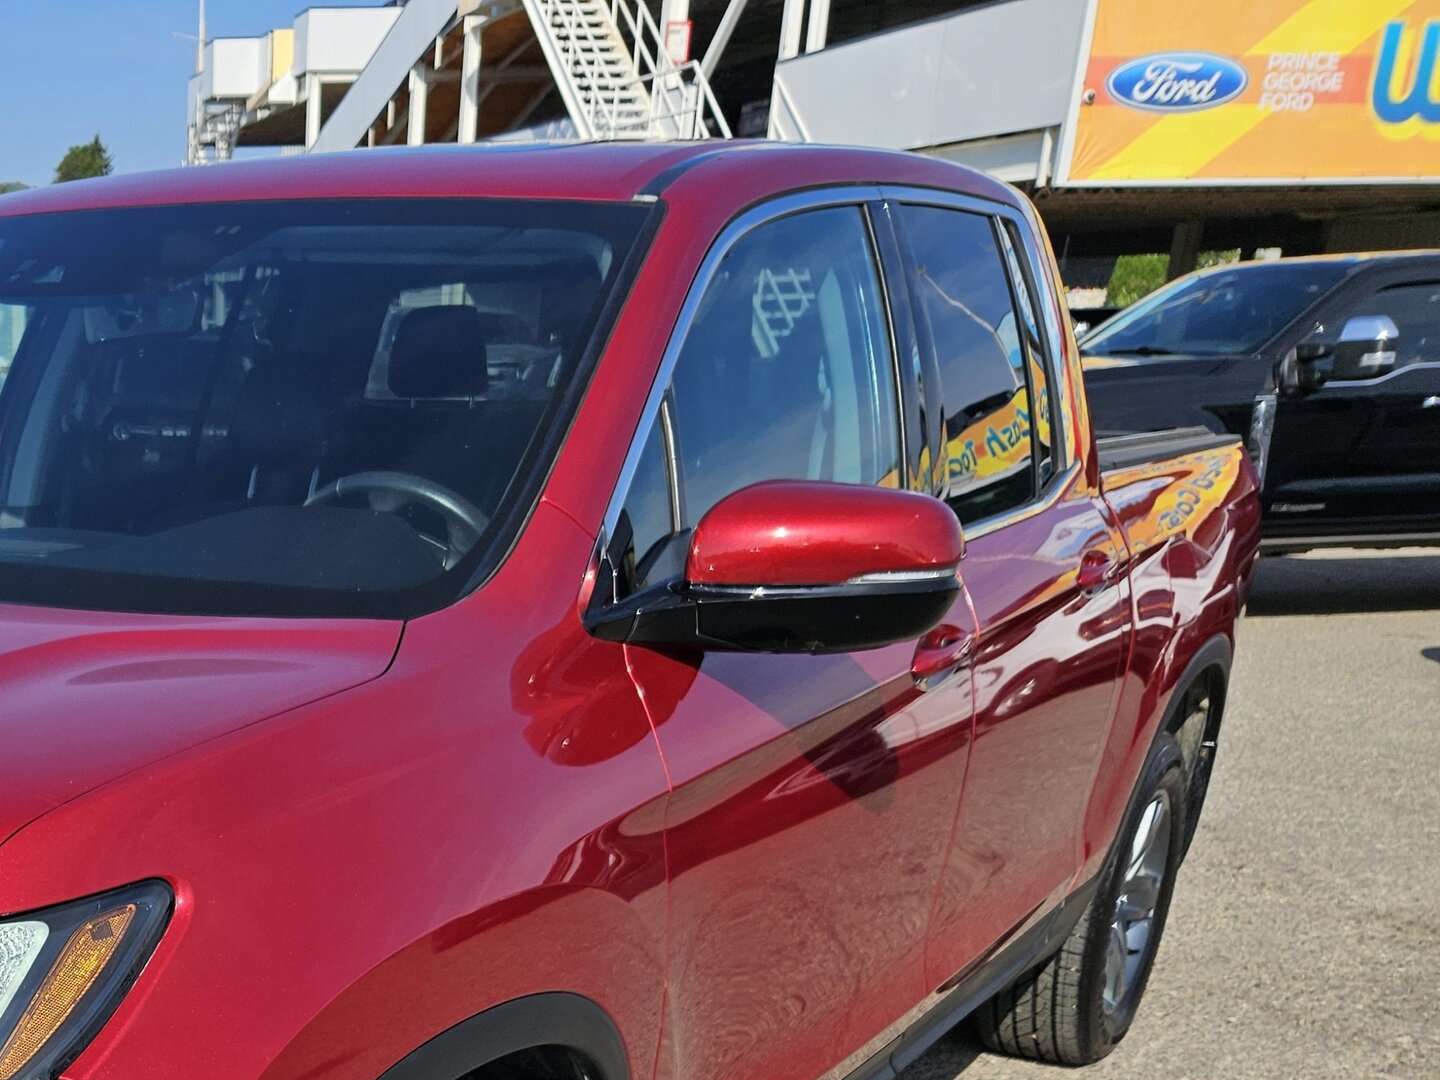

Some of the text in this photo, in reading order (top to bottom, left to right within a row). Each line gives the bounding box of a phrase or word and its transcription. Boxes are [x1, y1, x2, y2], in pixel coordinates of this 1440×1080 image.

[1267, 53, 1341, 71] PRINCE
[1131, 61, 1223, 103] Ford
[1262, 71, 1344, 92] GEORGE
[1258, 91, 1314, 112] FORD
